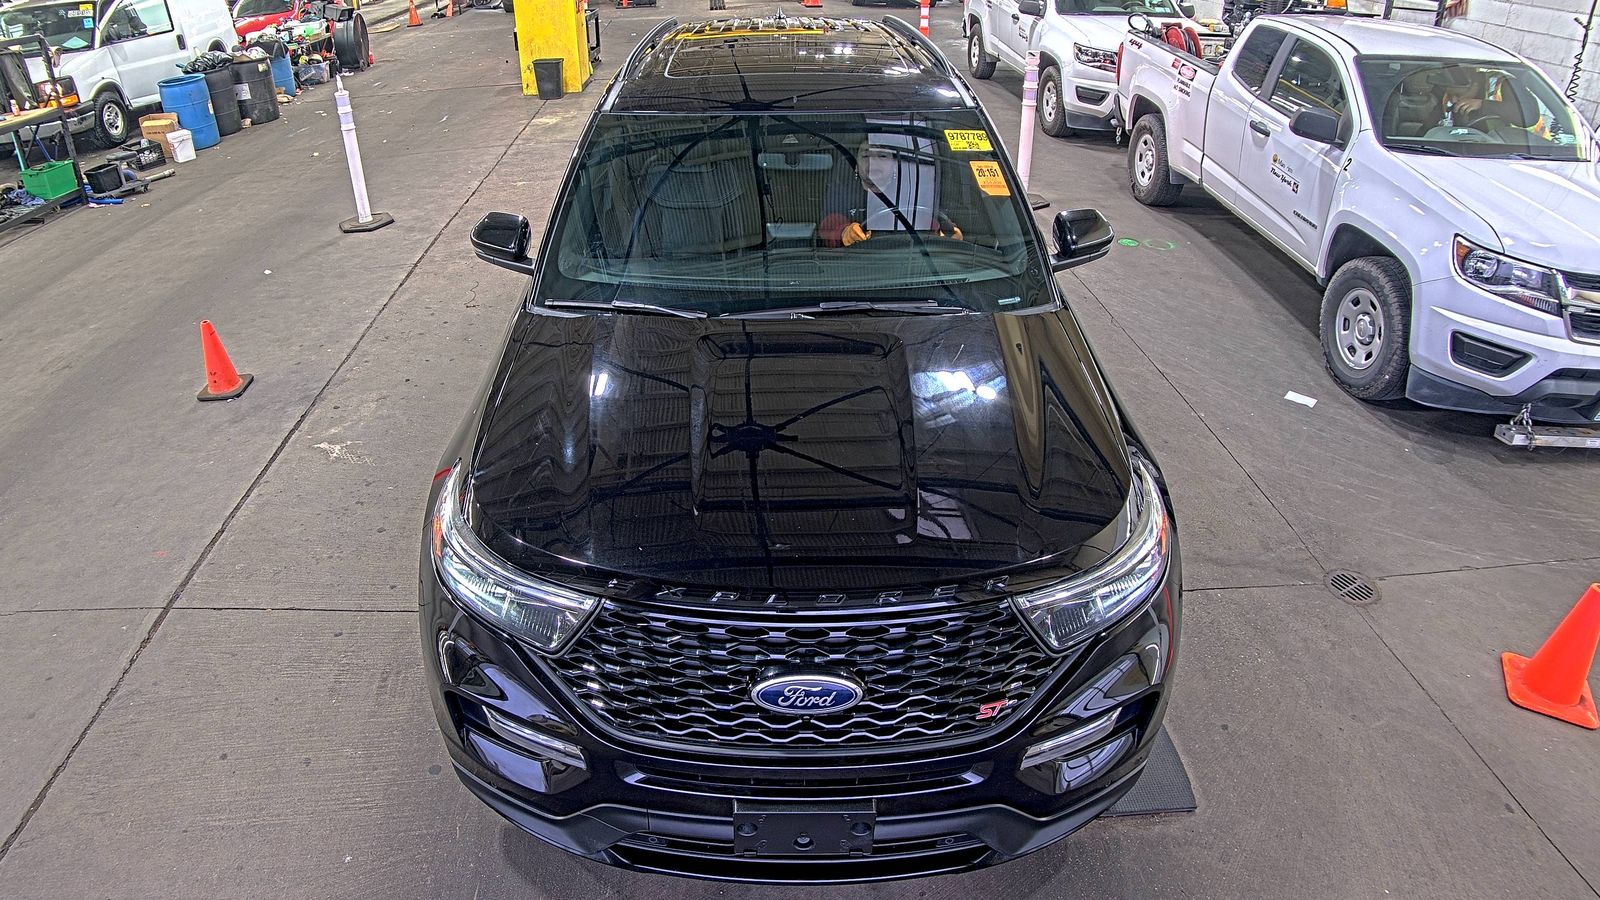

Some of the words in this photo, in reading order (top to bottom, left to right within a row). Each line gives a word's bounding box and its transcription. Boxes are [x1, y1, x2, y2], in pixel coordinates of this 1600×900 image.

[947, 132, 988, 141] 9787789
[1343, 158, 1352, 171] 2
[606, 575, 1010, 607] EXPLORER
[777, 685, 837, 707] Ford
[976, 698, 1008, 720] ST
